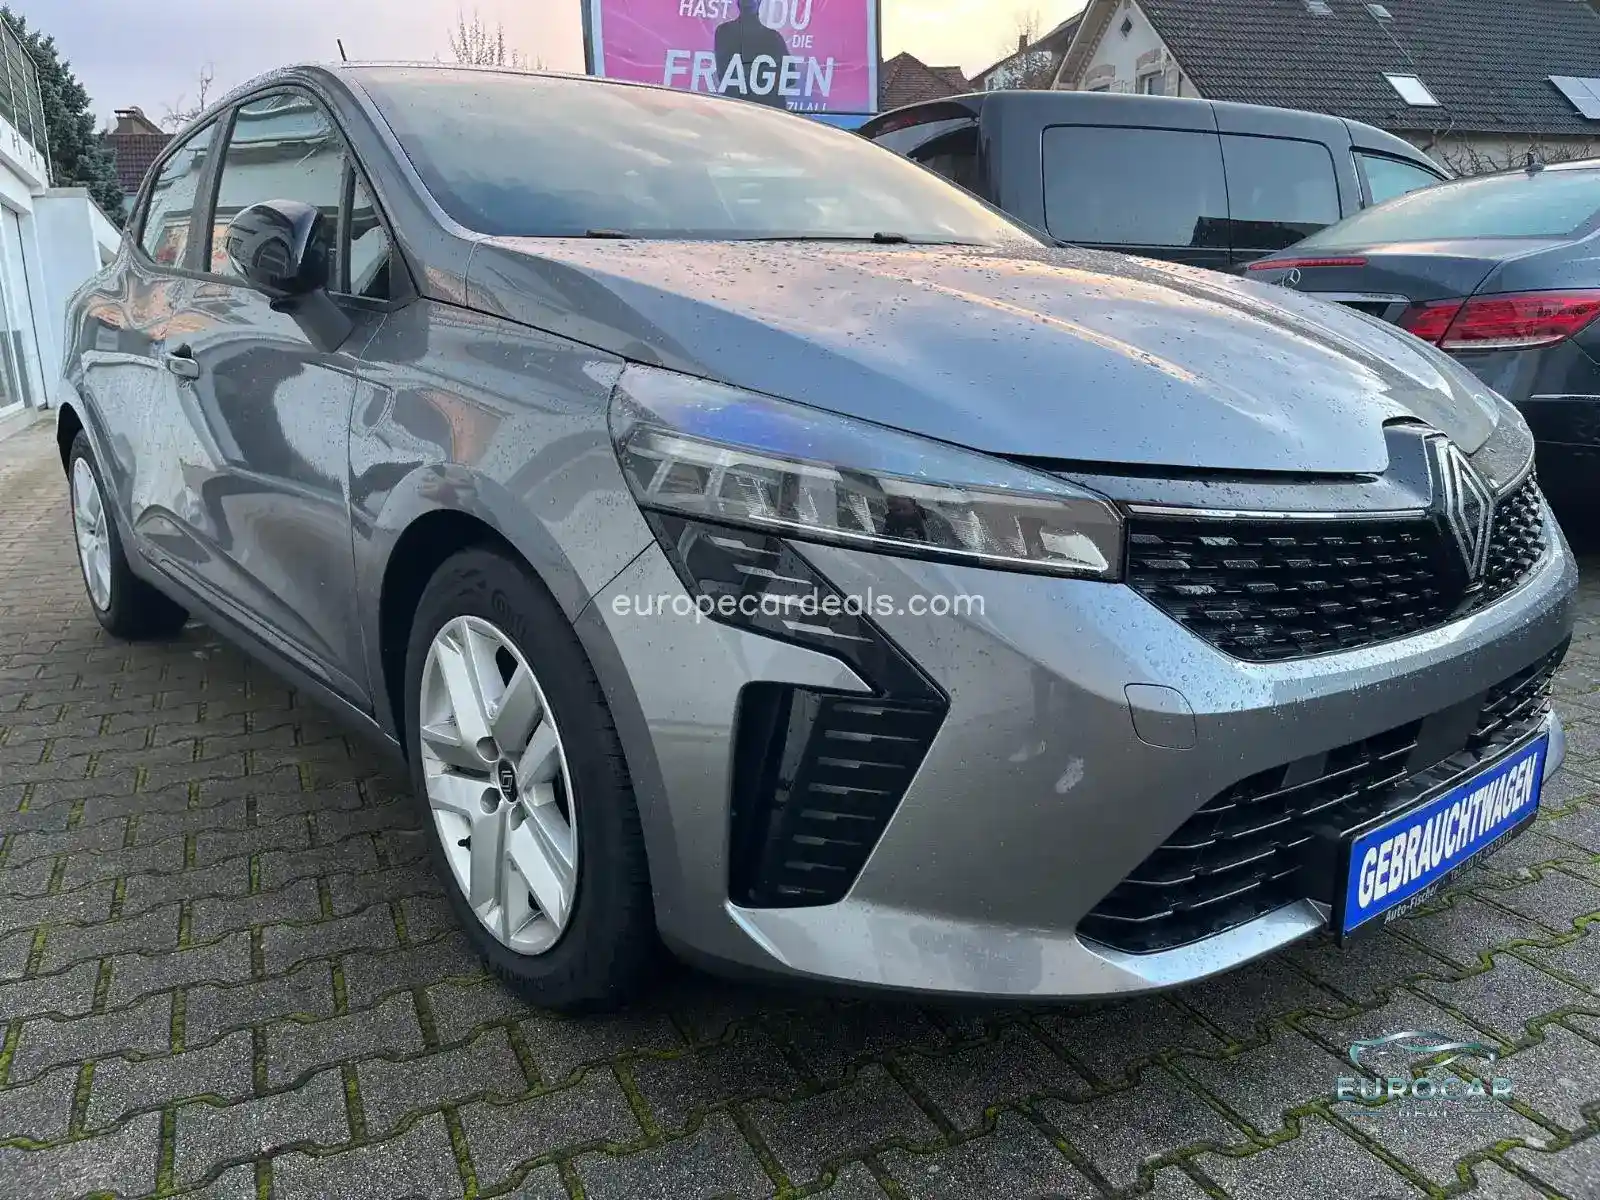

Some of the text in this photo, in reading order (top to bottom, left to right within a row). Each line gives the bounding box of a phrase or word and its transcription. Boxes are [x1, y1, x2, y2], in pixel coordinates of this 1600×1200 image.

[679, 0, 812, 29] HAST DU
[792, 34, 814, 48] DIE
[664, 49, 834, 96] FRAGEN
[1358, 752, 1538, 909] GEBRAUCHTWAGEN
